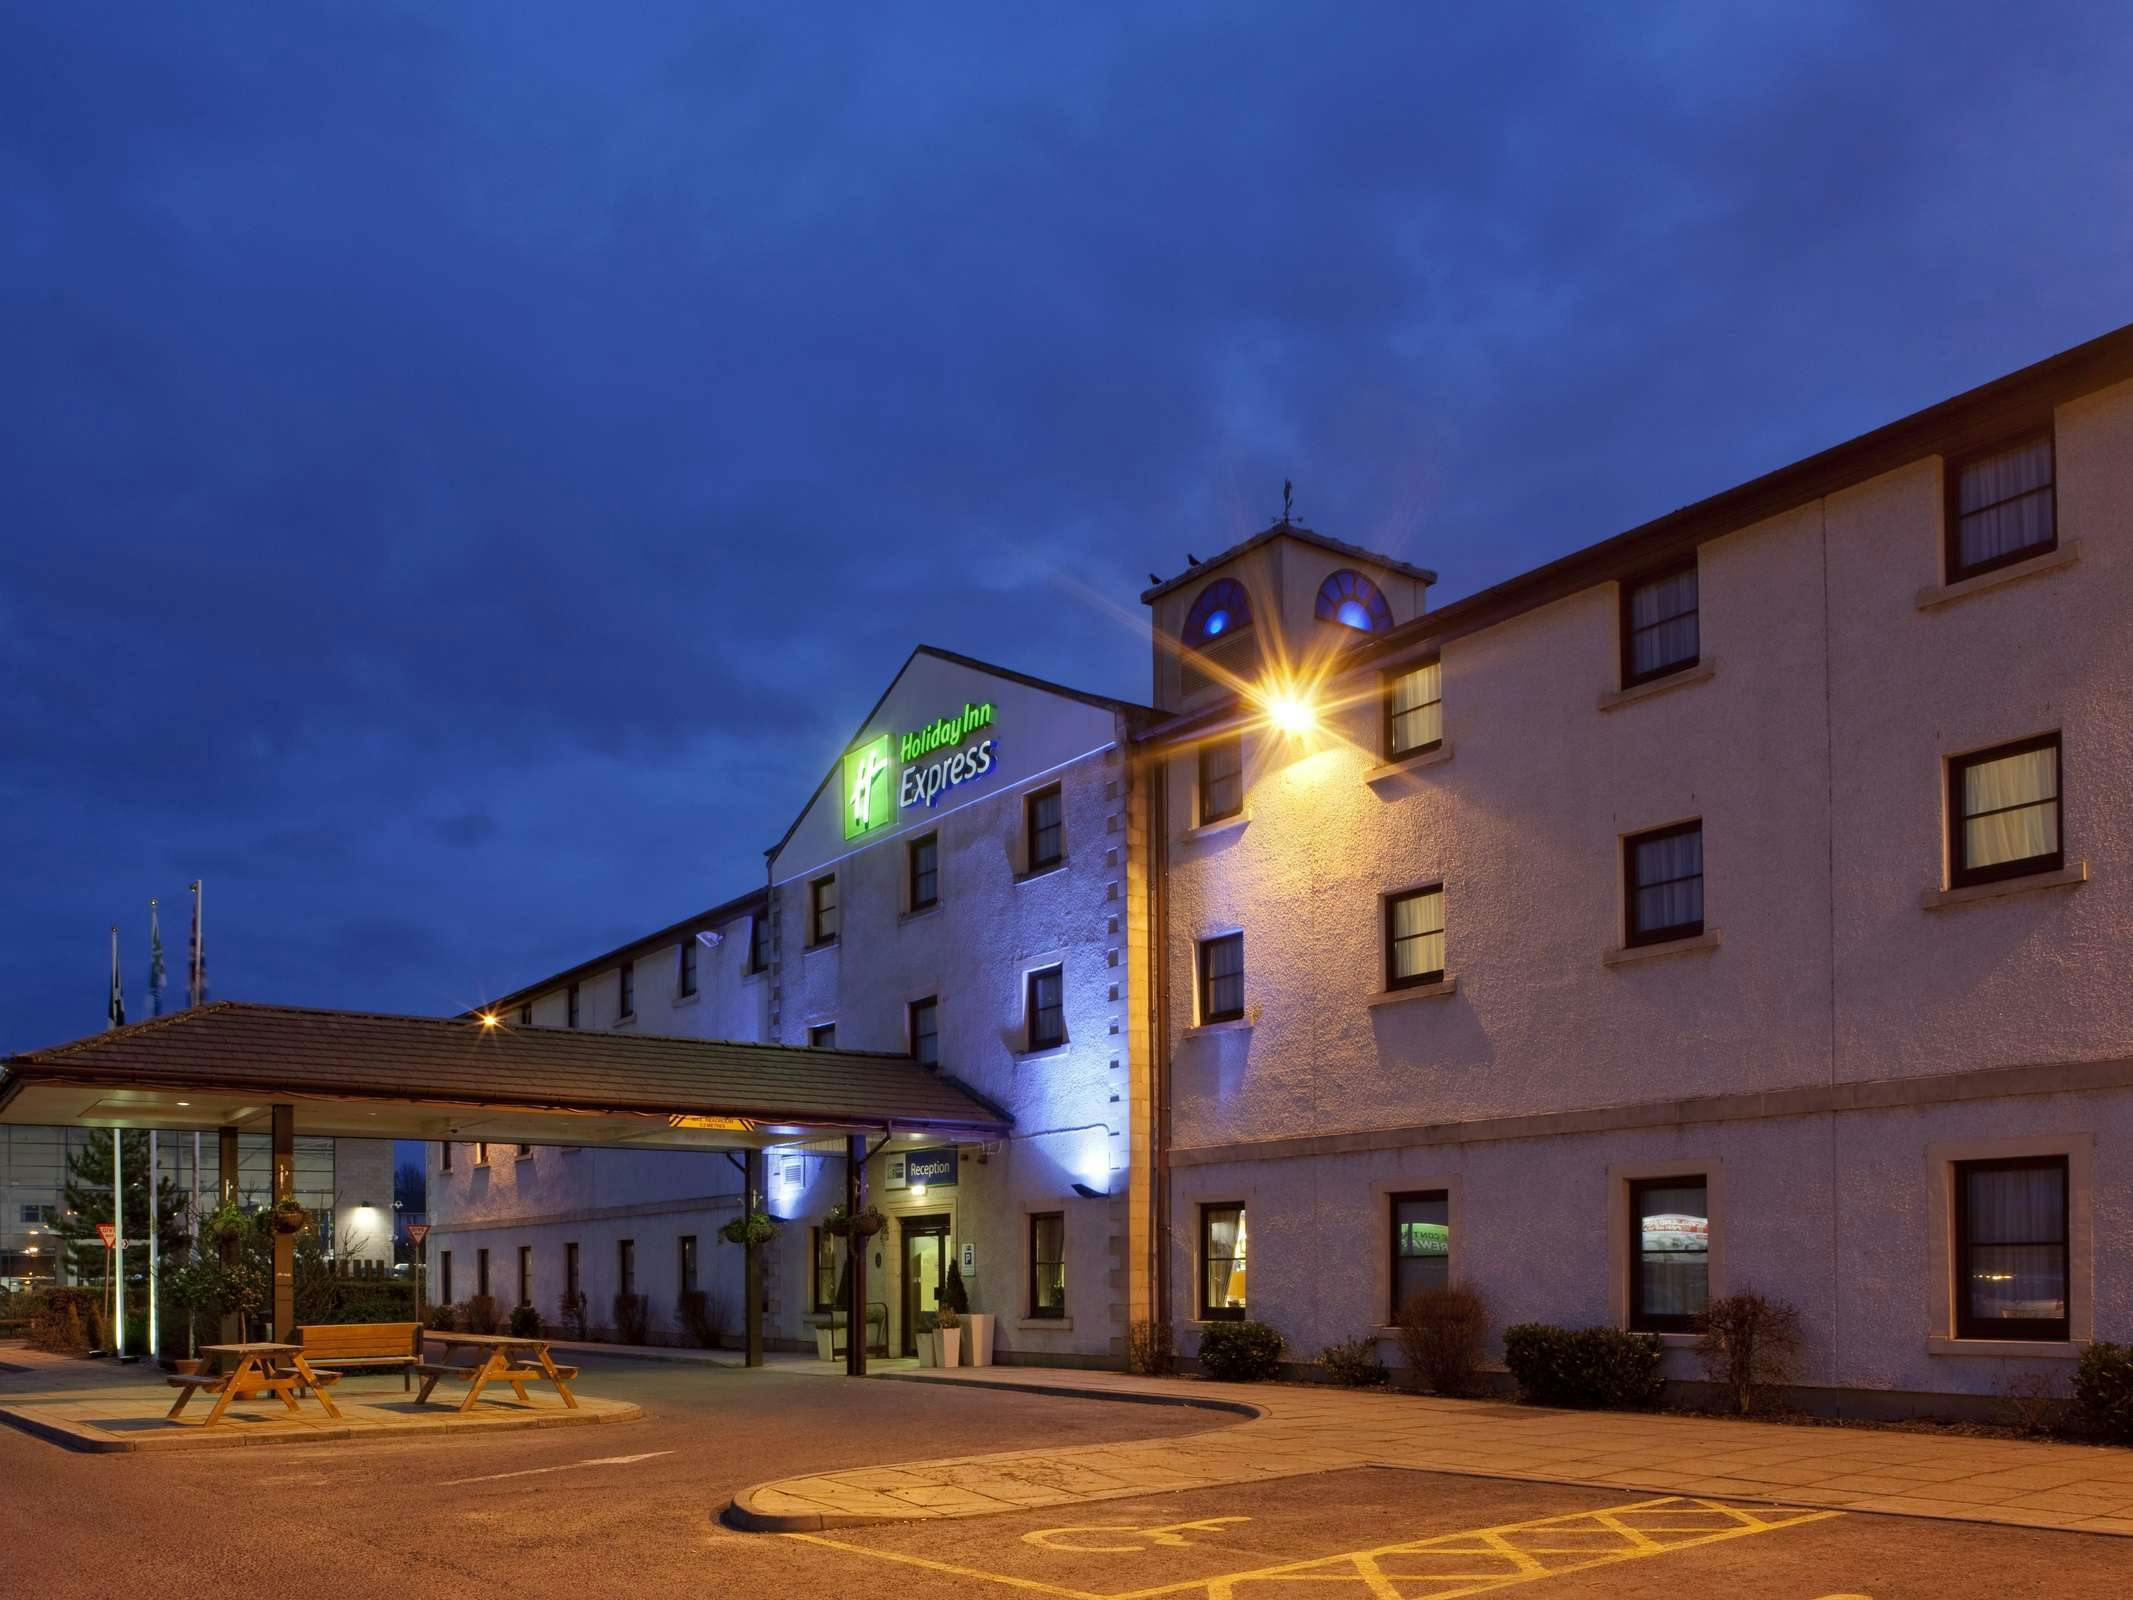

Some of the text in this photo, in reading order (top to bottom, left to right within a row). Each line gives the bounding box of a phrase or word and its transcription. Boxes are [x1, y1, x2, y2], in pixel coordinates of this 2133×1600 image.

[901, 703, 991, 763] Holiday Inn
[900, 740, 991, 808] Express
[910, 1160, 950, 1177] Reception
